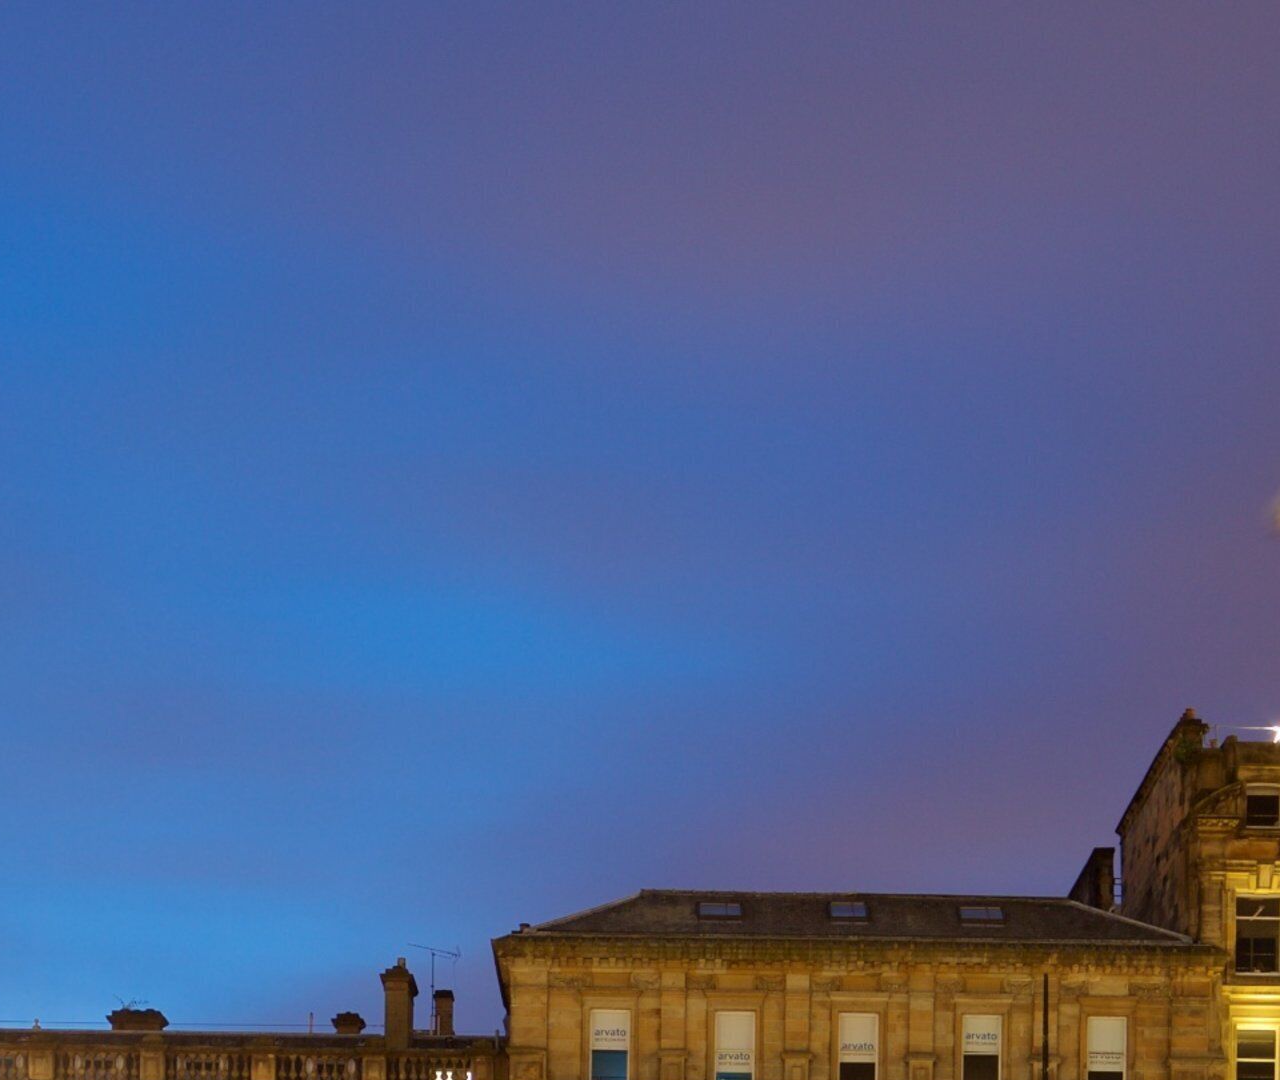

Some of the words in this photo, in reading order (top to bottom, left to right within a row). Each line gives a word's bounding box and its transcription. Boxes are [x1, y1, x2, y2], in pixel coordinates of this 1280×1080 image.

[594, 1028, 626, 1037] arvato
[965, 1032, 998, 1040] arvato
[842, 1042, 874, 1050] arvato
[718, 1052, 750, 1061] arvato
